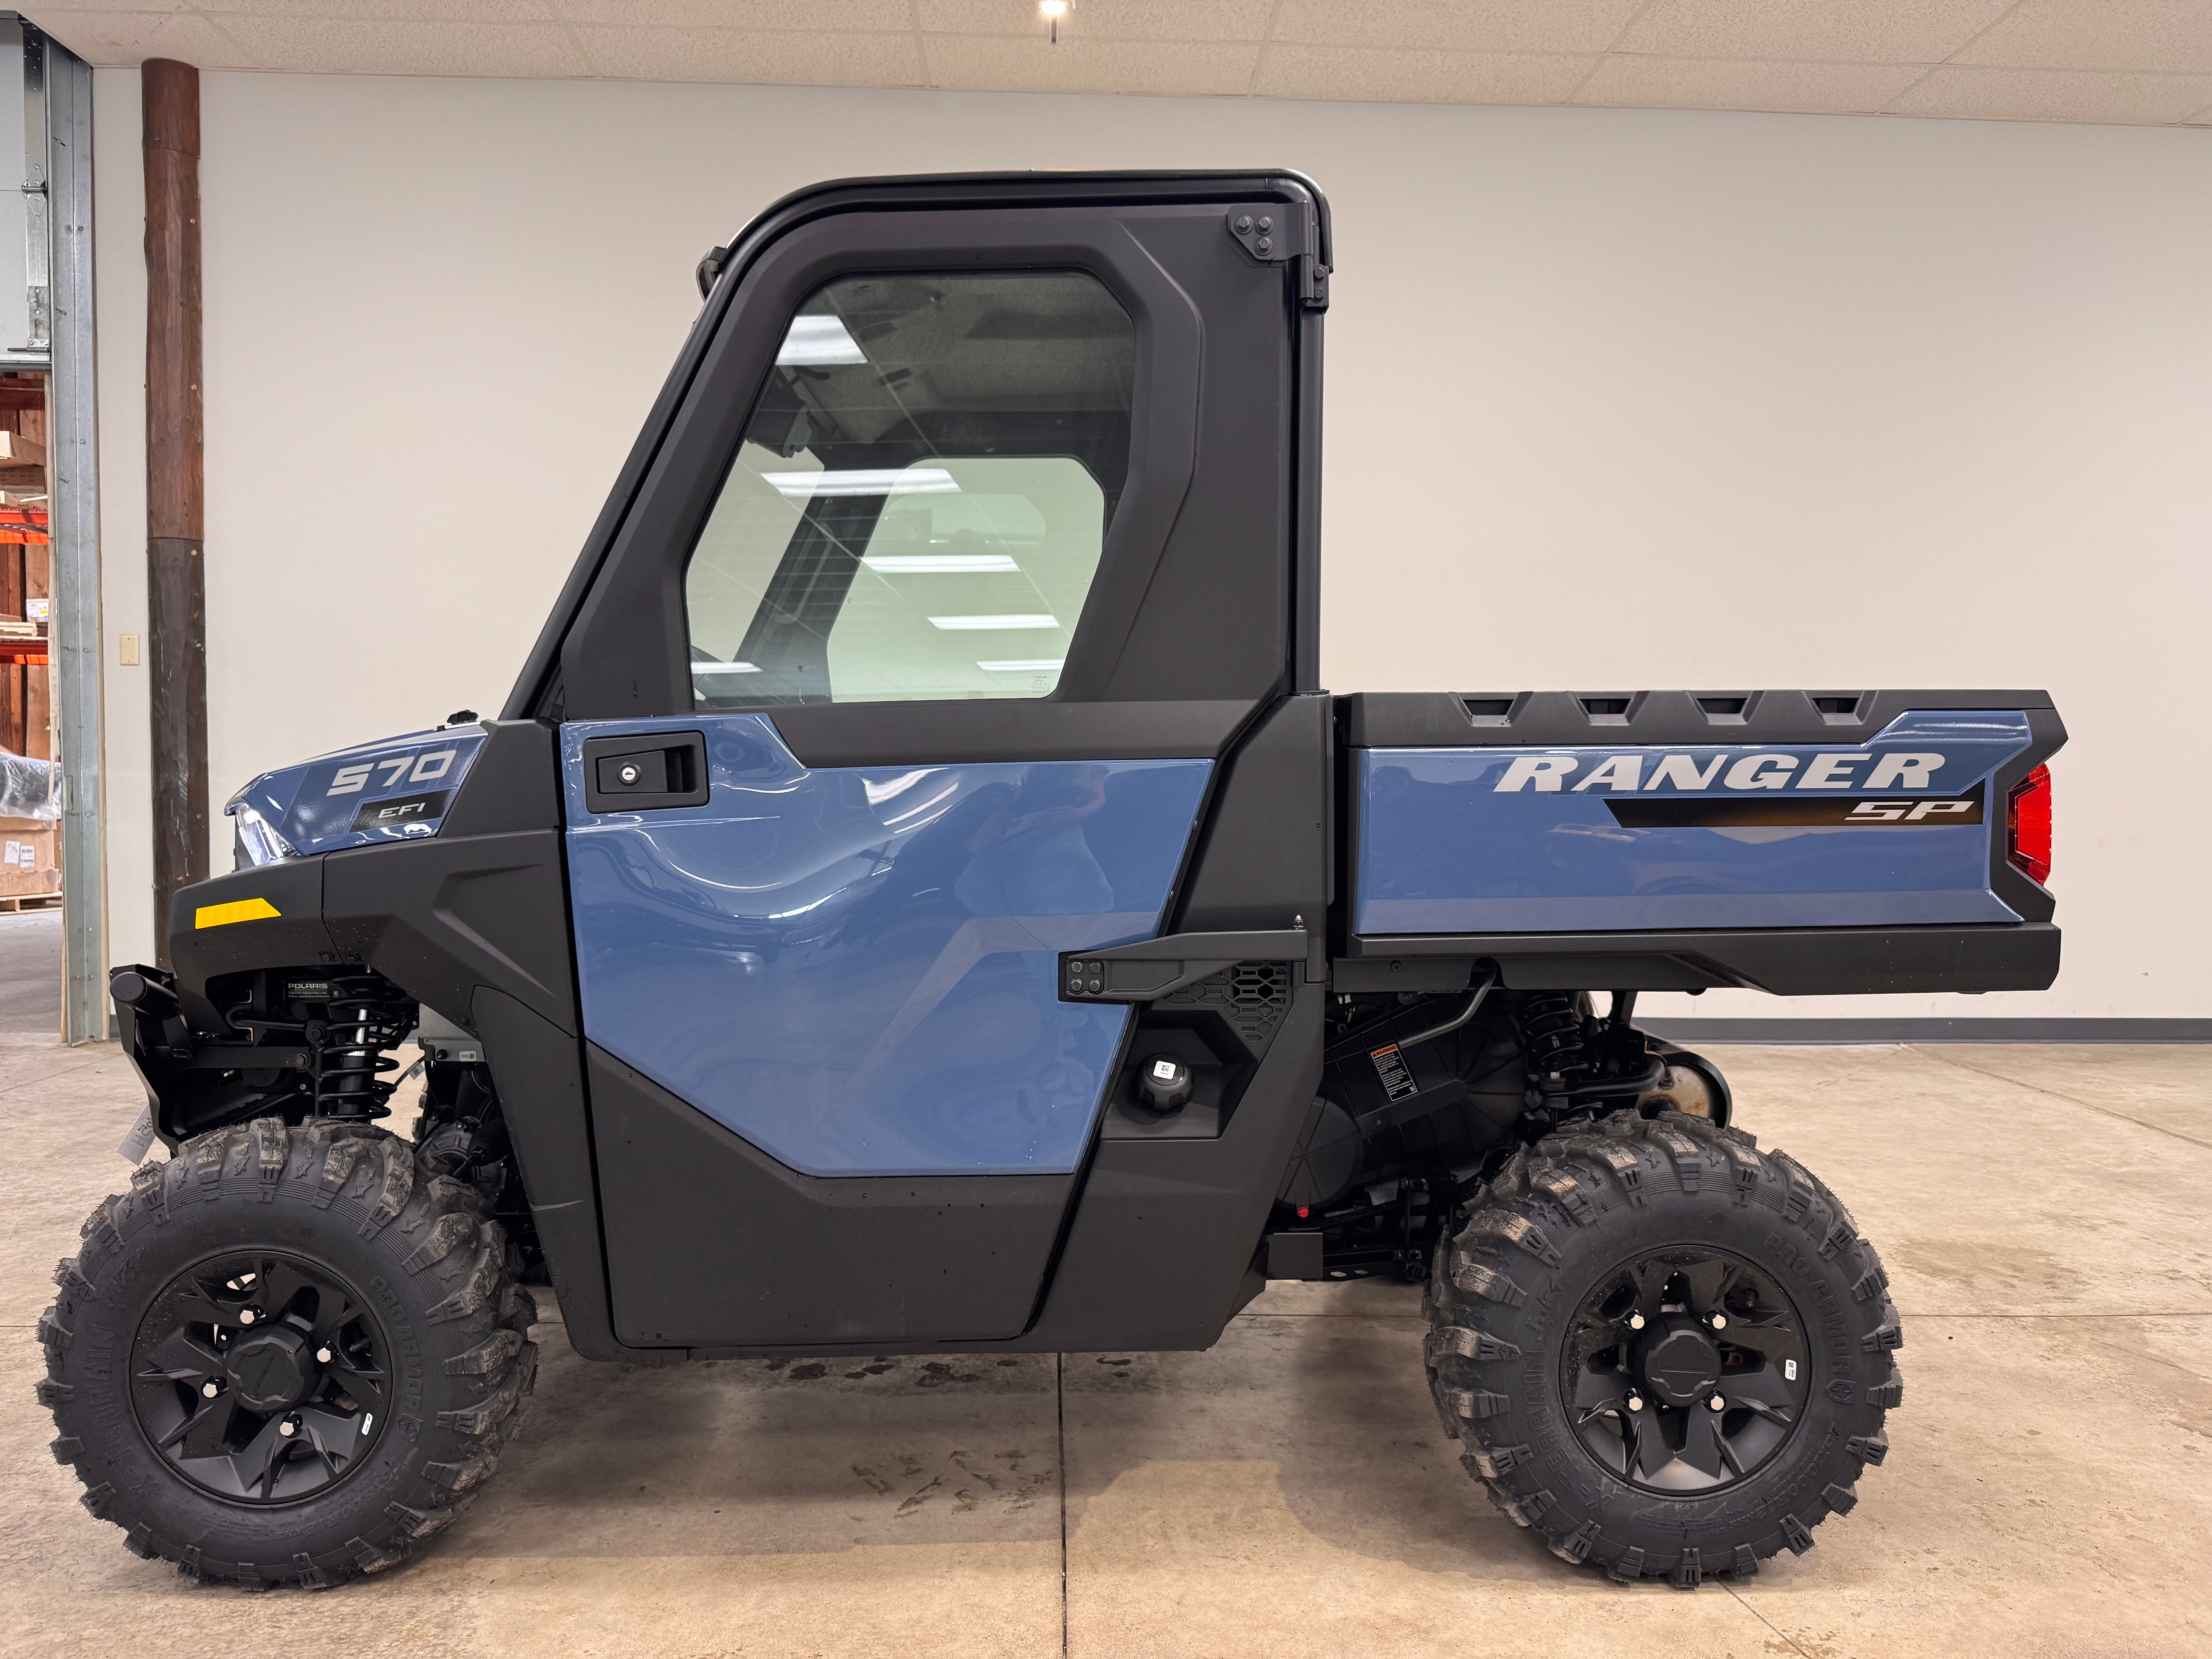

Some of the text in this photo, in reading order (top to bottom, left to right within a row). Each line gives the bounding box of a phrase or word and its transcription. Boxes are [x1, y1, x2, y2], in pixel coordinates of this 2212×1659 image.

[326, 749, 457, 796] 570
[1493, 753, 1945, 792] RANGER
[378, 802, 426, 819] EFI
[1844, 801, 1975, 820] SP
[1376, 1046, 1396, 1056] WARNING
[1764, 1233, 1852, 1374] PRO ARMOR
[396, 1326, 422, 1412] ARMOR
[1523, 1350, 1614, 1516] X-TERRAIN
